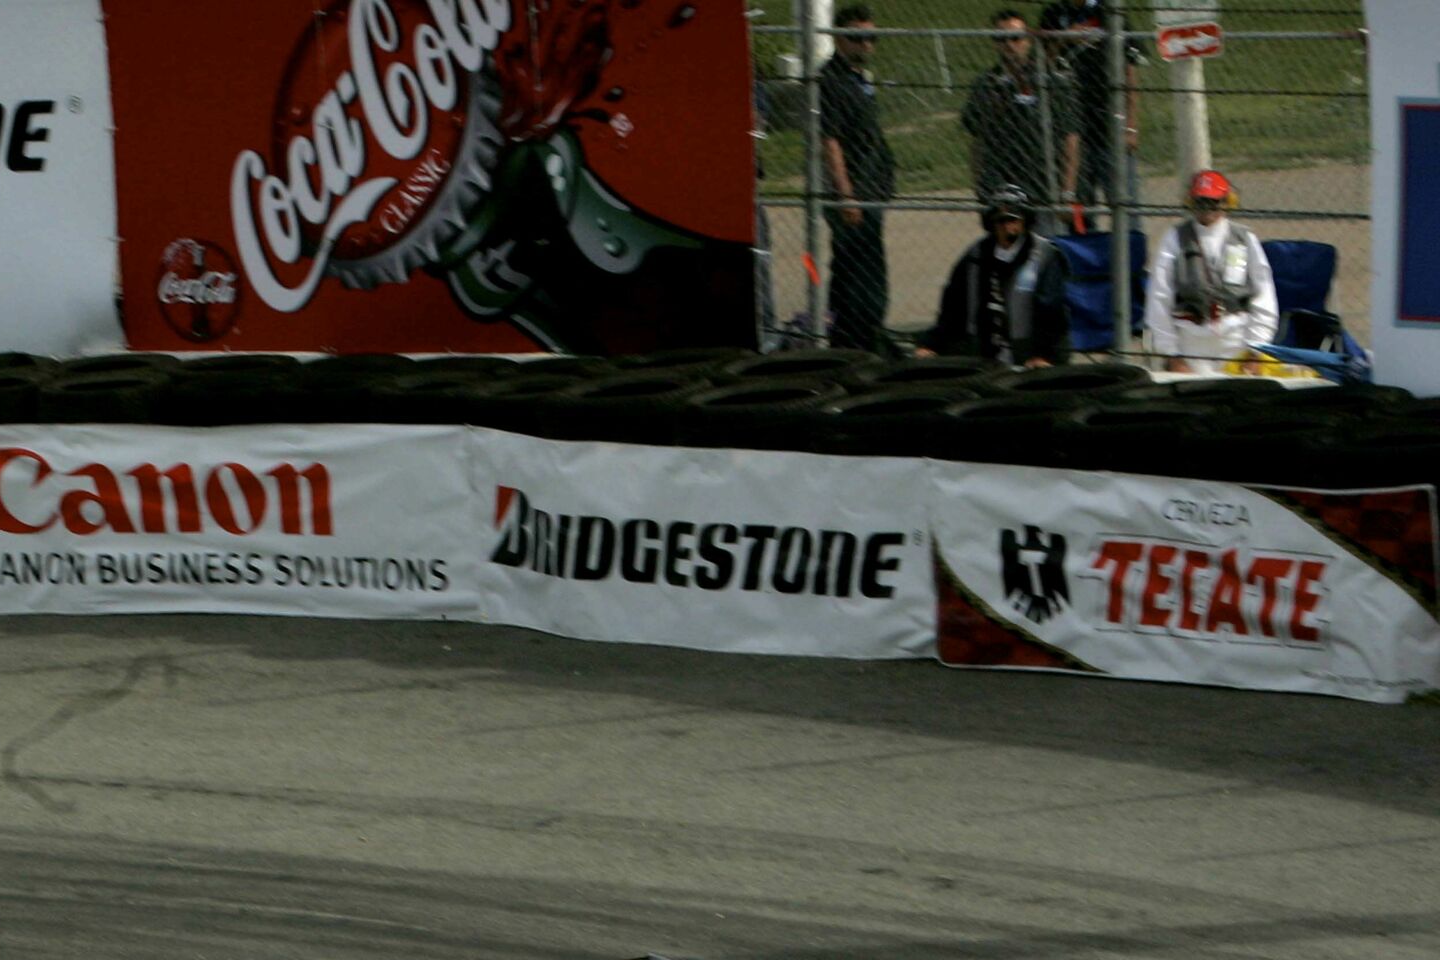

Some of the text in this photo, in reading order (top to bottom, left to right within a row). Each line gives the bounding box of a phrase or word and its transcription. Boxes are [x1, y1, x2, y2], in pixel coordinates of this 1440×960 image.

[379, 148, 451, 234] CLASSIC
[98, 553, 264, 587] BUSINESS
[274, 555, 451, 592] SOLUTIONS
[490, 485, 906, 599] BRIDGESTONE
[1090, 540, 1328, 643] TECATE
